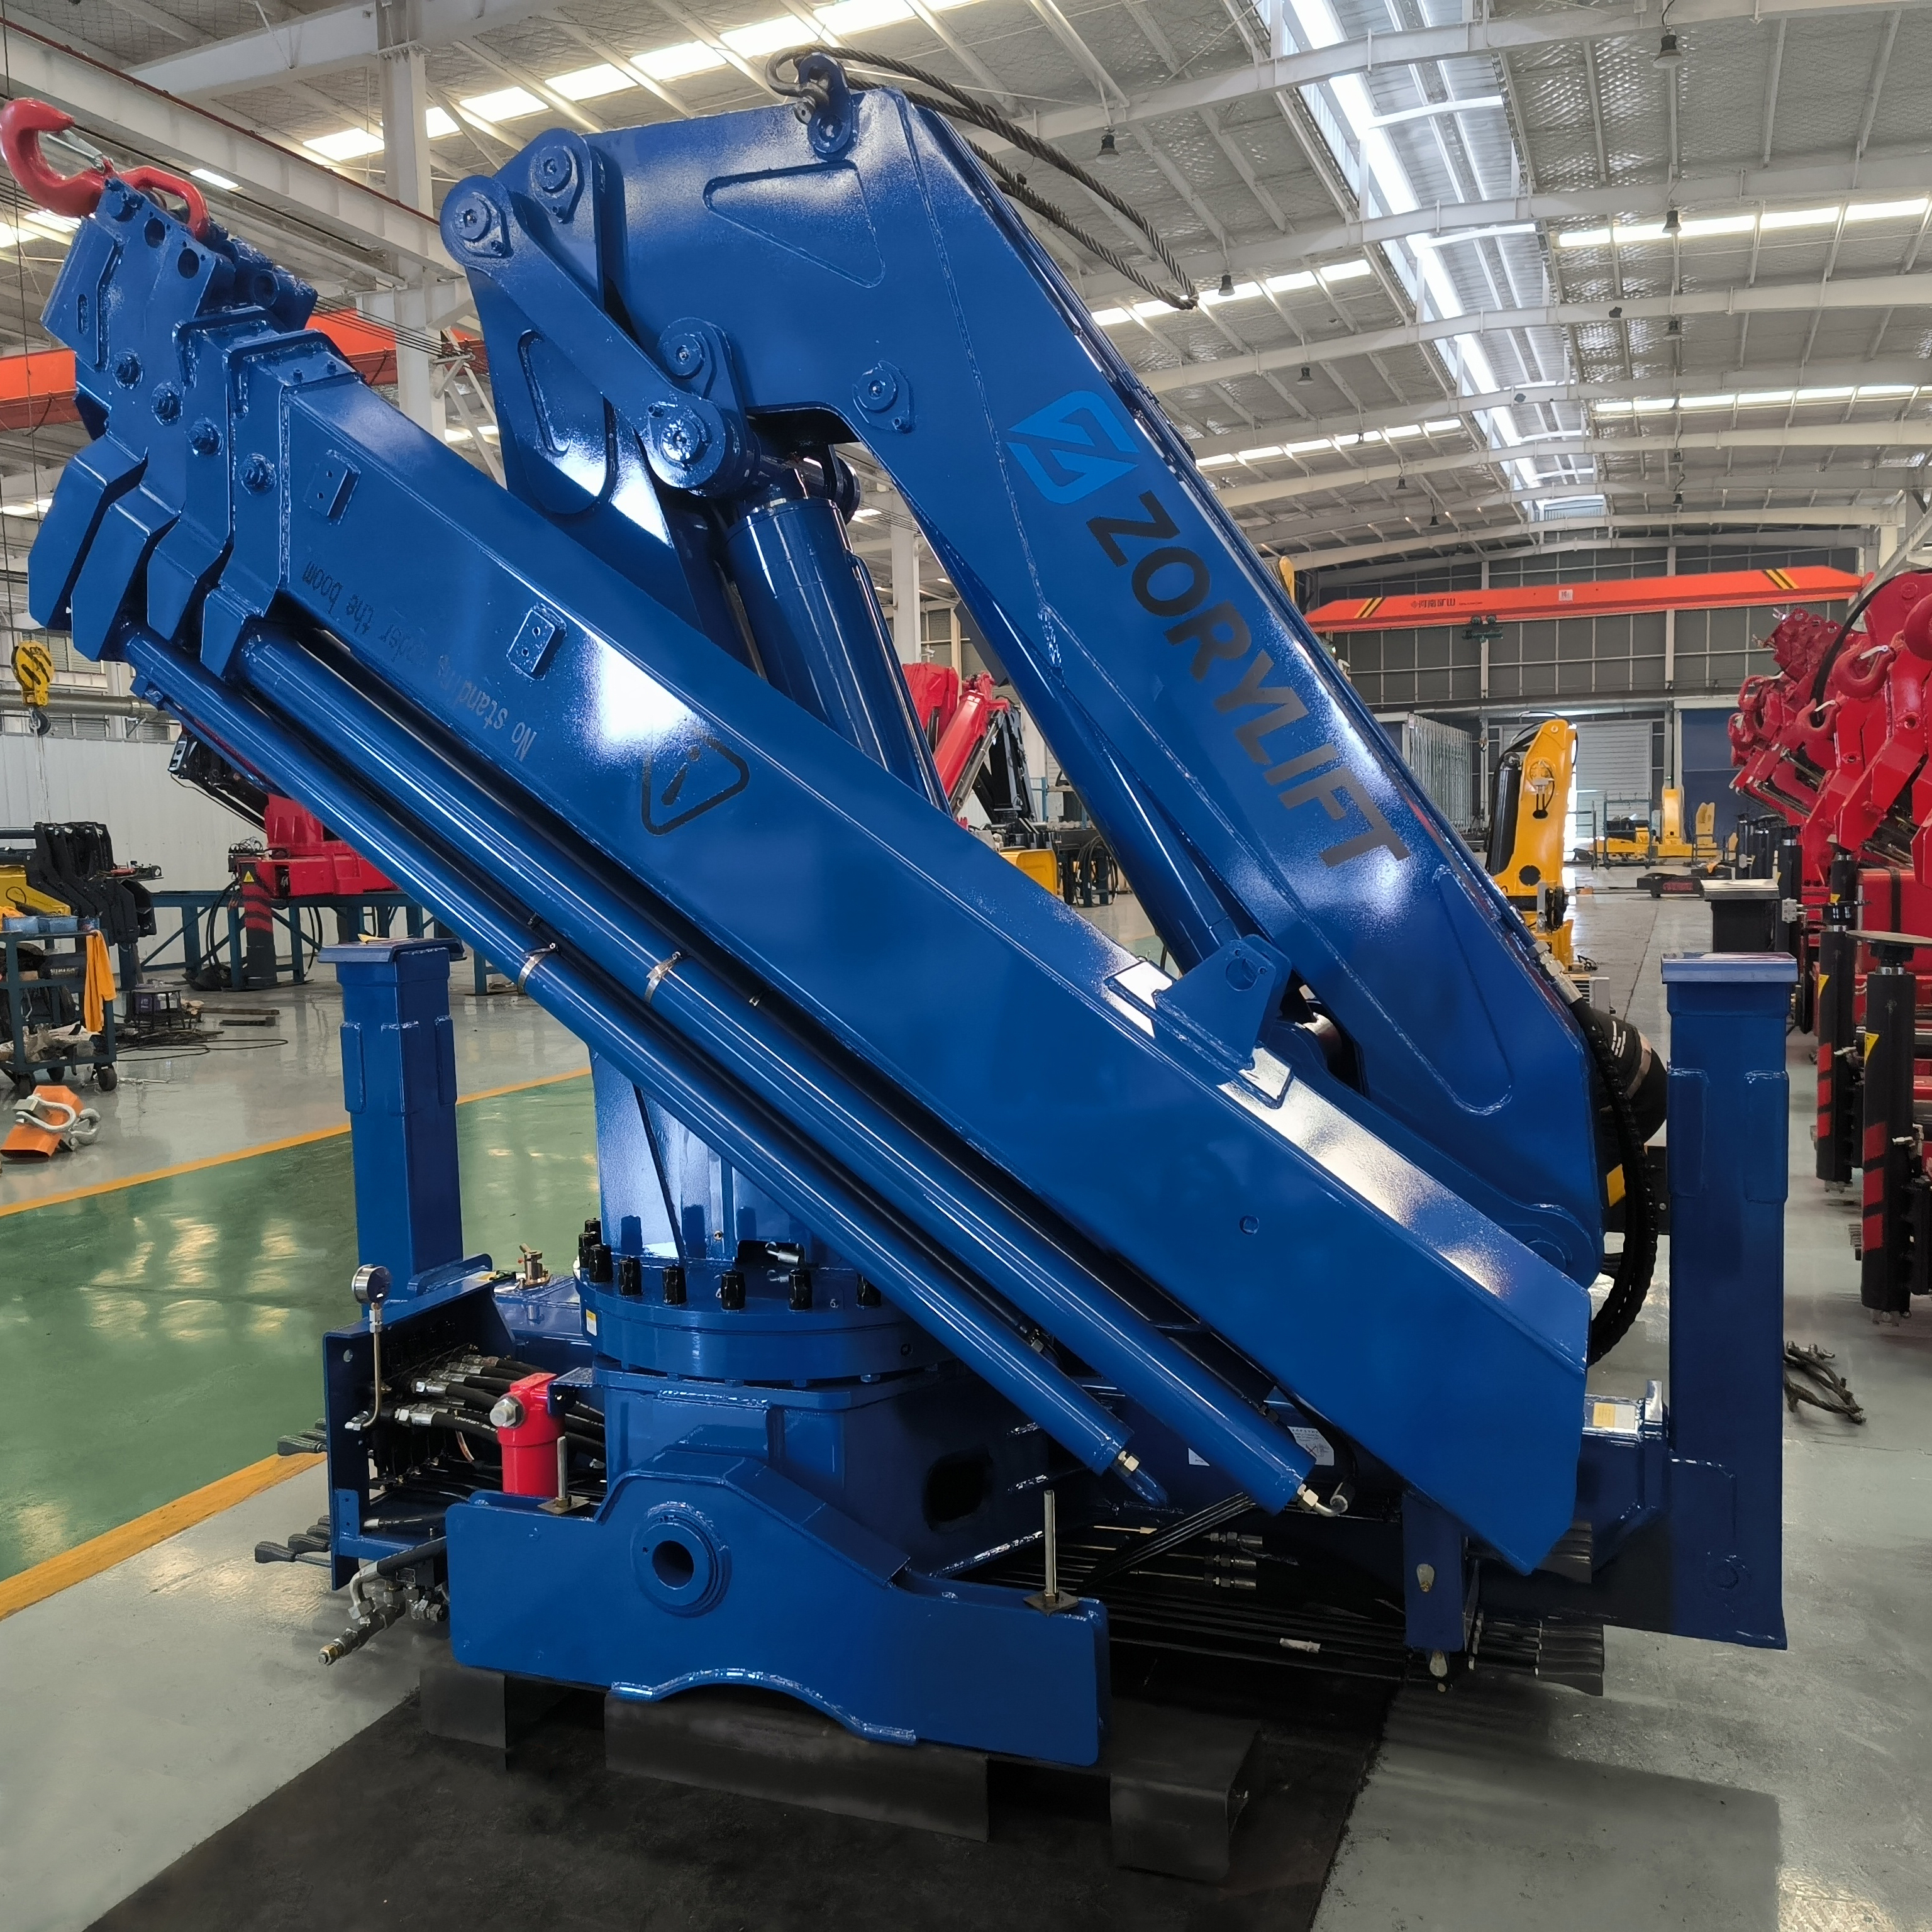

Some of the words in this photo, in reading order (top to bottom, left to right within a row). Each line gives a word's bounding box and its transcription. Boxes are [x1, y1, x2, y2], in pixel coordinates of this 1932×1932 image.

[303, 560, 343, 614] boom
[346, 594, 374, 635] the
[1086, 490, 1410, 867] ZORYLIFT
[511, 722, 538, 762] No
